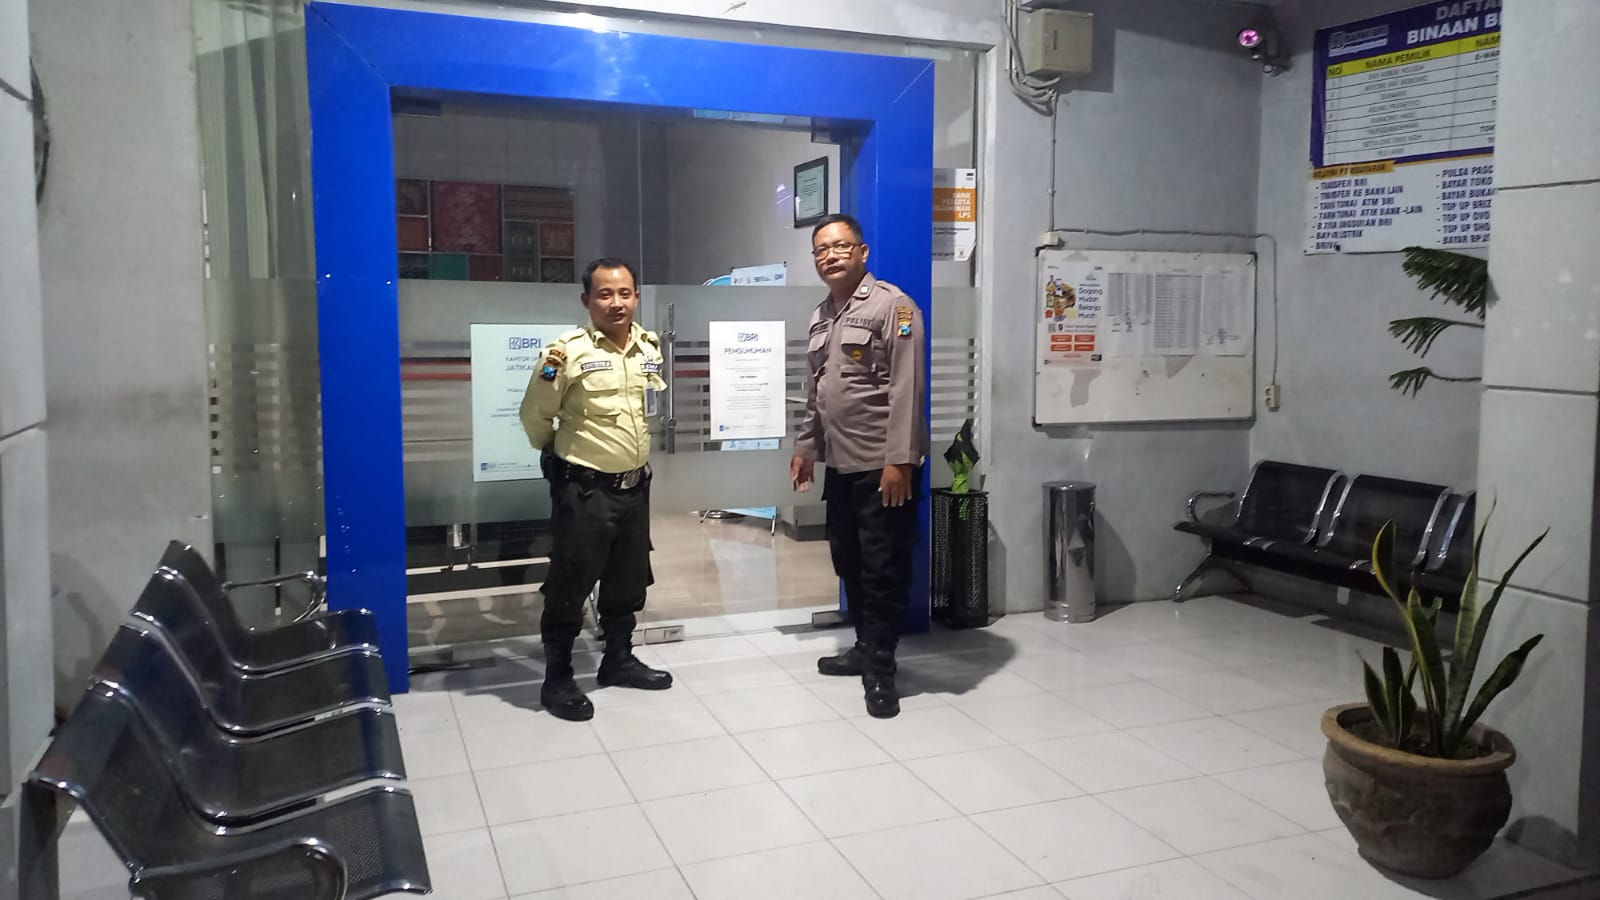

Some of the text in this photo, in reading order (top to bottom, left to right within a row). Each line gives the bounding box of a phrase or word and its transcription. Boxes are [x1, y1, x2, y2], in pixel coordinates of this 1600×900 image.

[1406, 13, 1501, 45] BINAAN B
[1328, 65, 1343, 75] NO
[1365, 57, 1393, 68] NAMA
[1395, 49, 1431, 64] PEMILIK
[1442, 168, 1468, 178] PULSA
[1354, 178, 1368, 187] BRI
[1442, 179, 1468, 189] BAYAR
[1353, 189, 1363, 197] KE
[1365, 187, 1386, 197] BANK
[1387, 185, 1404, 194] LAIN
[1442, 190, 1467, 200] BAYAR
[1361, 198, 1378, 207] ATM
[1381, 197, 1395, 206] BRI
[1442, 202, 1457, 211] TOP
[1459, 201, 1470, 210] UP
[1360, 208, 1378, 217] ATM
[1379, 207, 1401, 216] BANK
[1442, 213, 1457, 222] TOP
[1459, 212, 1470, 221] UP
[1378, 218, 1393, 227] BRI
[1442, 224, 1457, 233] TOP
[1460, 223, 1471, 232] UP
[1442, 235, 1468, 244] BAYAR
[522, 338, 541, 348] BRI
